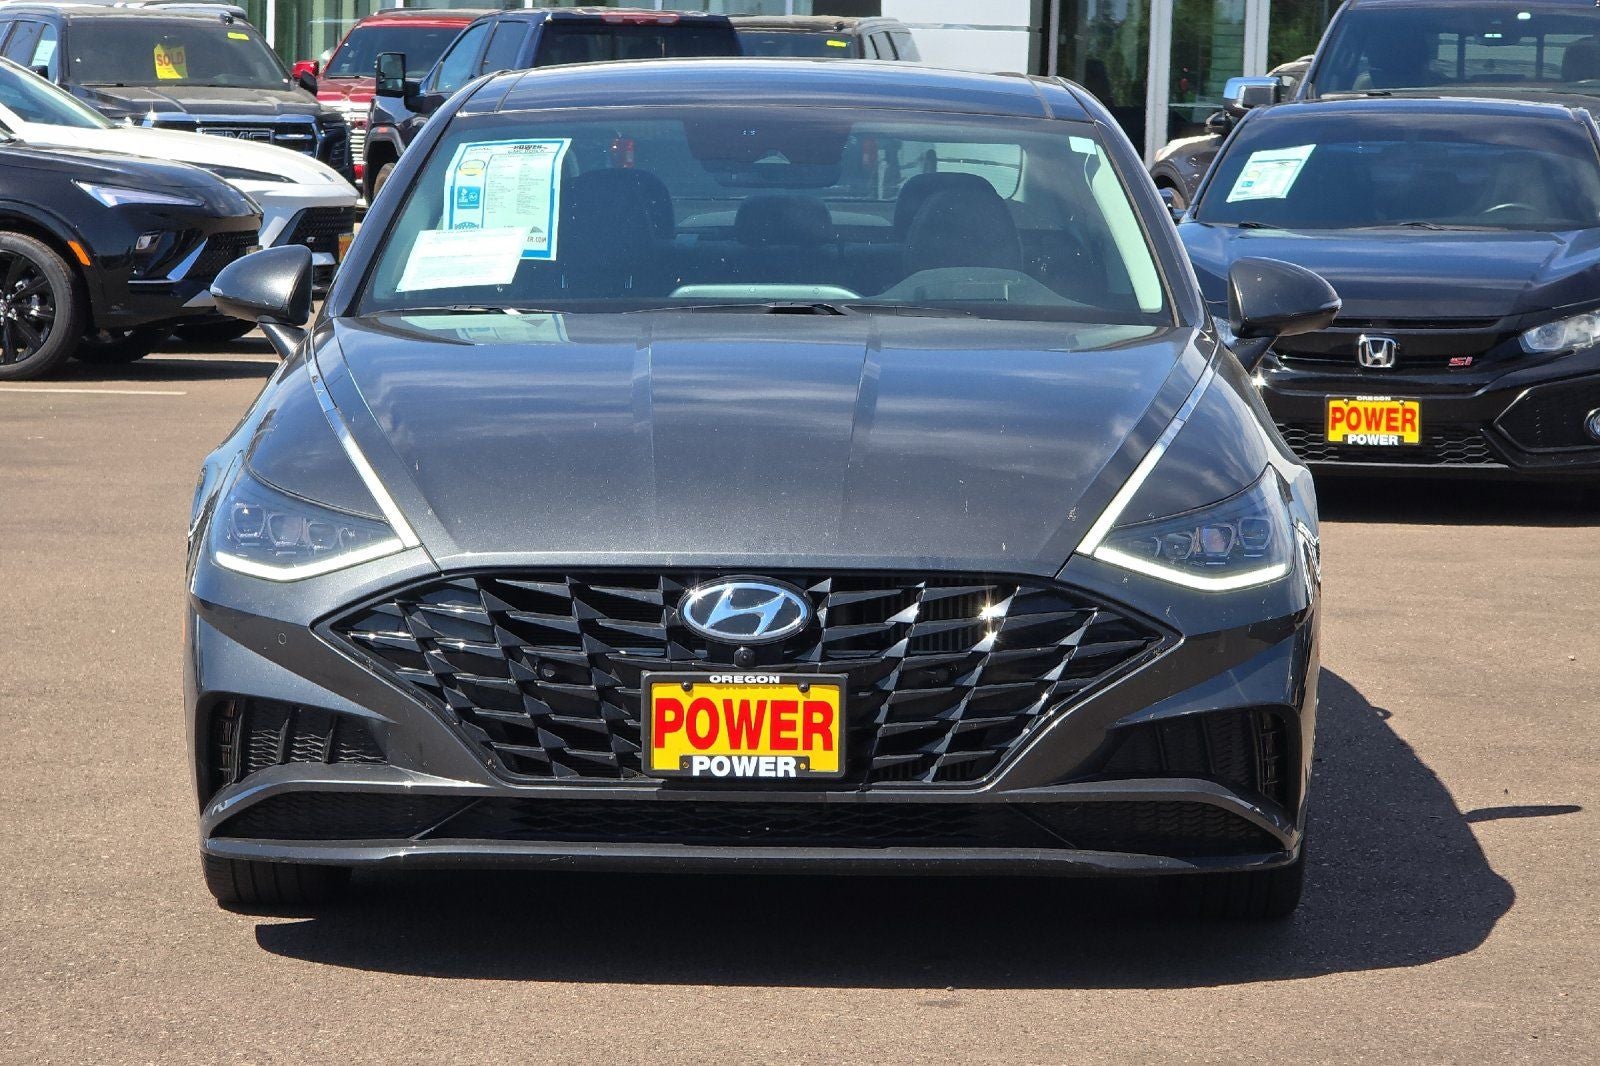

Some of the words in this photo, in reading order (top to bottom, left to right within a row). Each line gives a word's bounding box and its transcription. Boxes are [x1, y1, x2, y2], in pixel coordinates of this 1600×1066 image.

[156, 52, 184, 66] SOLD
[1331, 406, 1417, 432] POWER
[1347, 434, 1398, 445] POWER
[709, 675, 780, 684] OREGON
[654, 697, 833, 751] POWER
[692, 756, 796, 778] POWER
